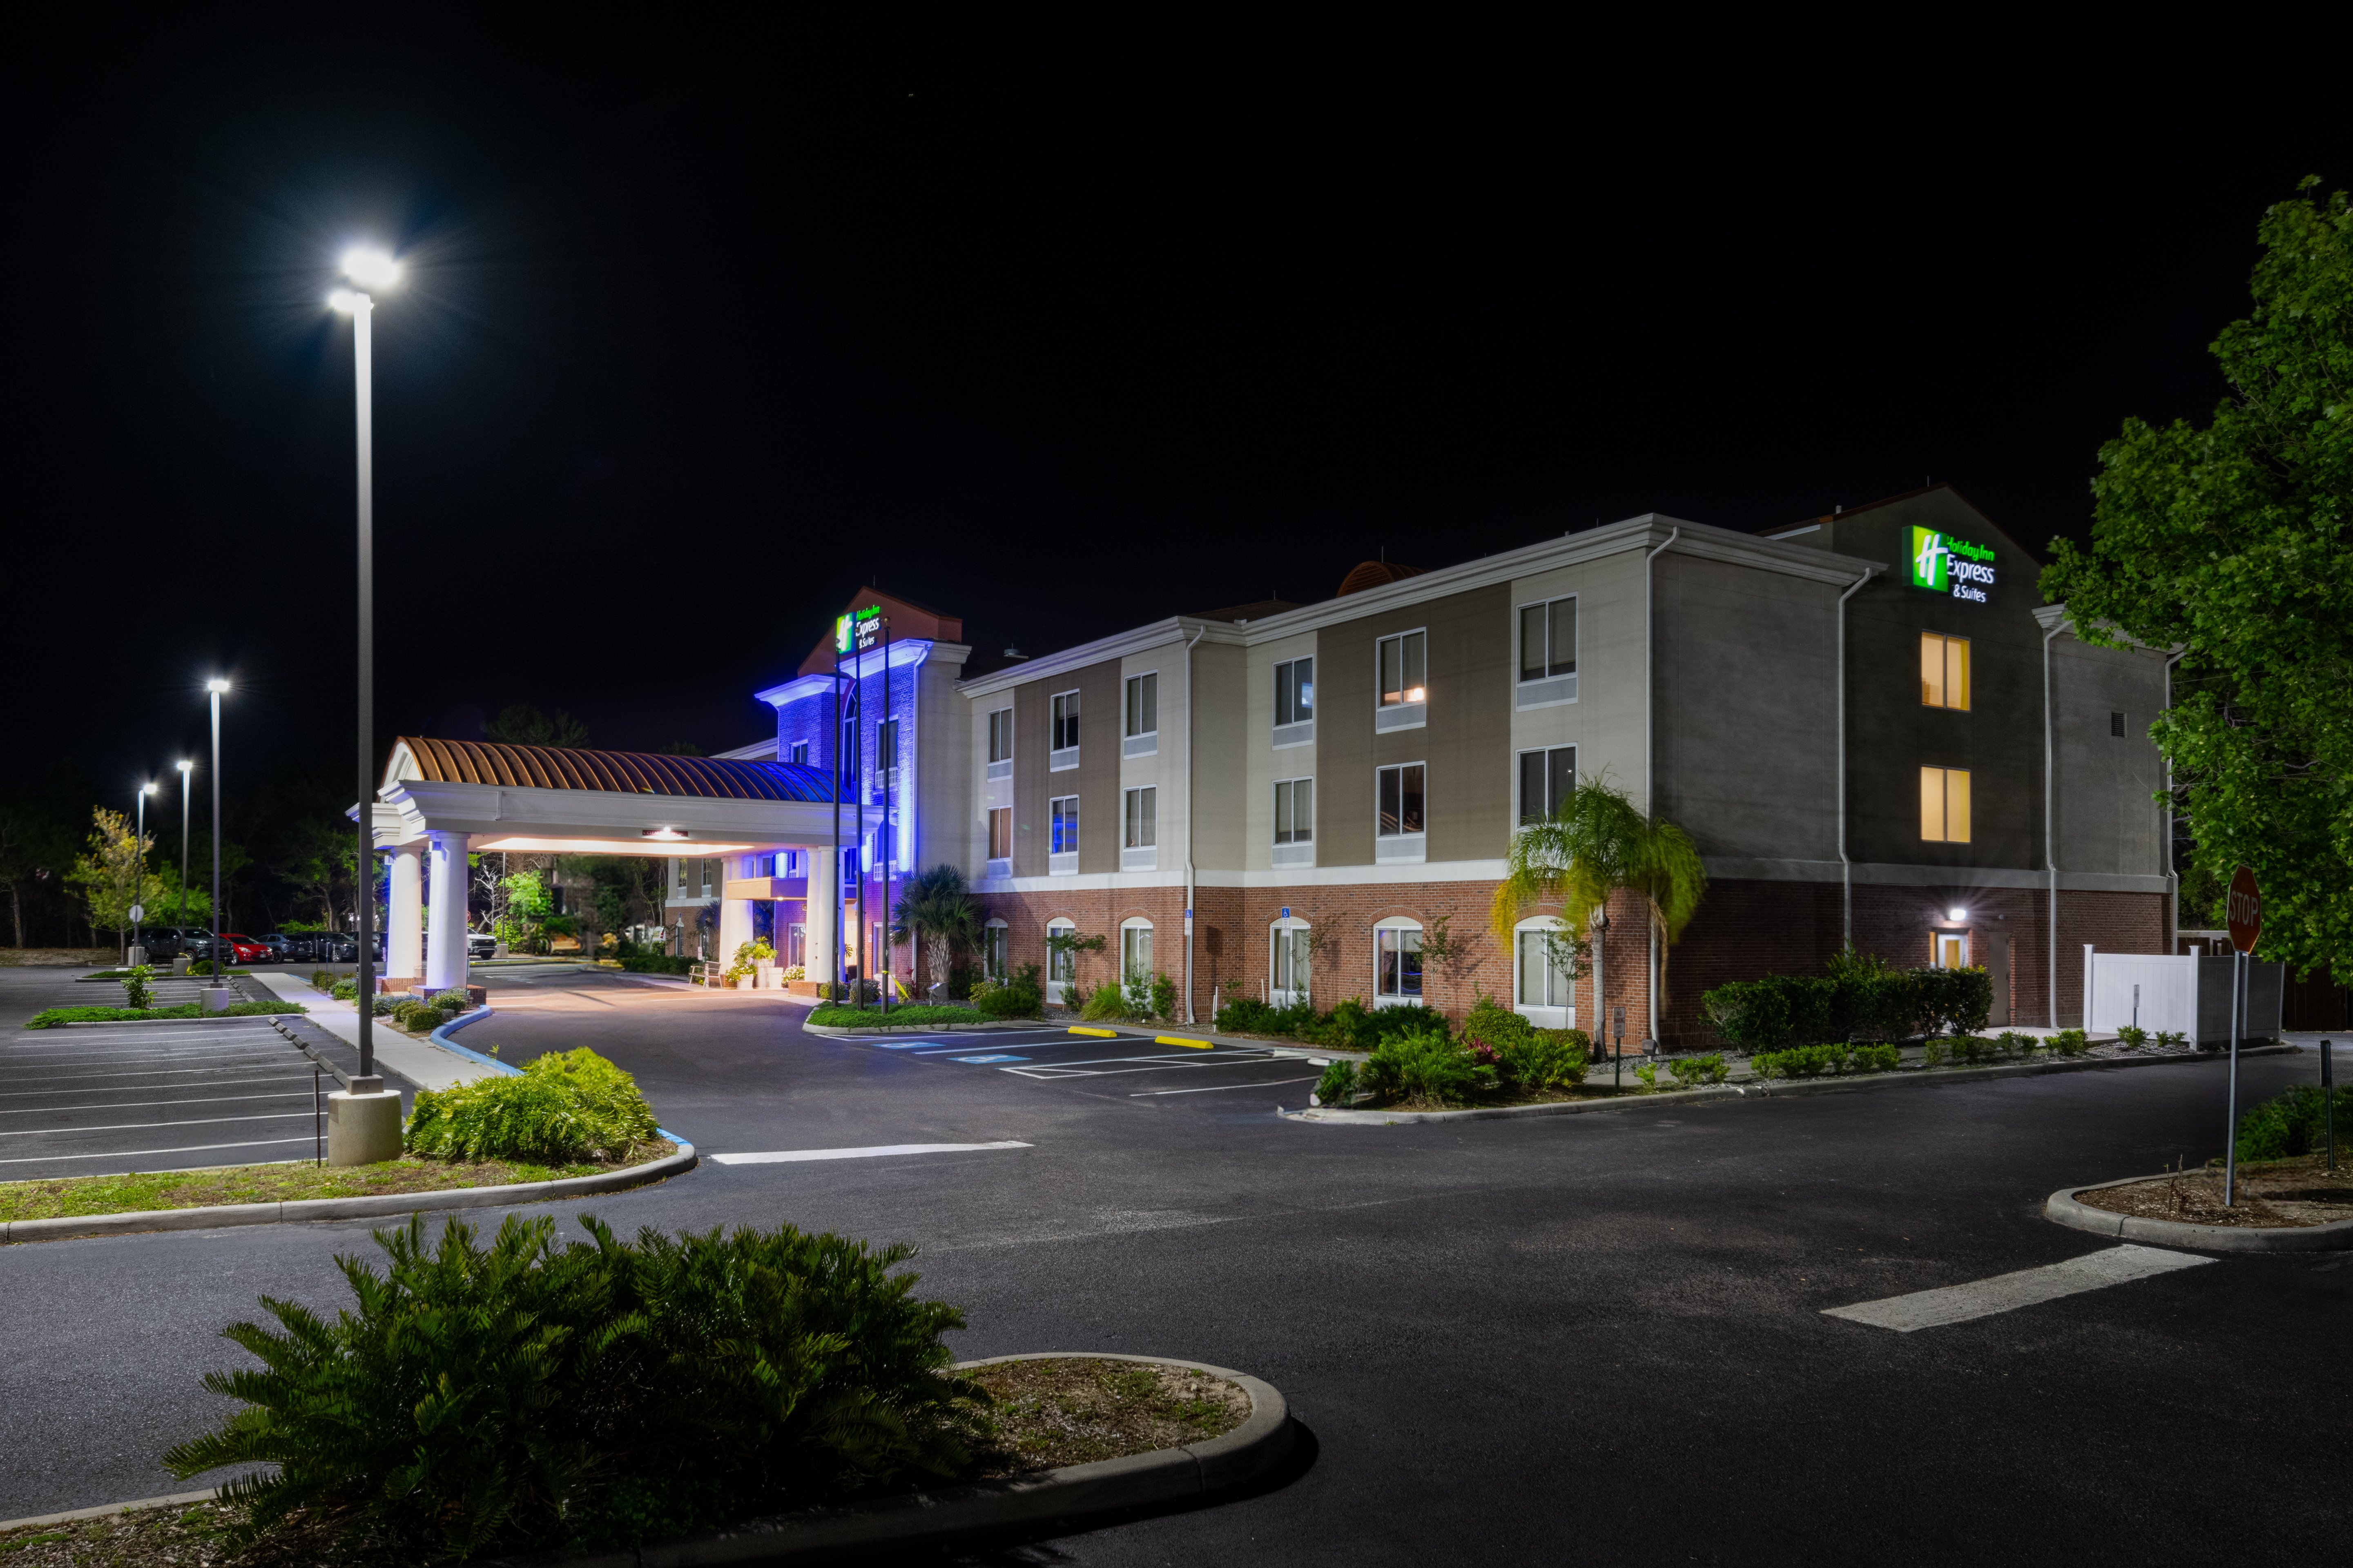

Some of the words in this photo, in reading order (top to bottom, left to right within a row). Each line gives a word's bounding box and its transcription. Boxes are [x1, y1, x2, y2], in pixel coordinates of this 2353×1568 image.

[1947, 536, 1978, 561] Holiday
[1981, 544, 1995, 561] Inn
[1947, 554, 1994, 583] Express
[1953, 584, 1960, 597] &
[1961, 586, 1986, 602] Suites
[856, 608, 872, 621] Holiday
[859, 639, 863, 648] &
[863, 637, 874, 647] Suites
[2230, 890, 2258, 926] STOP
